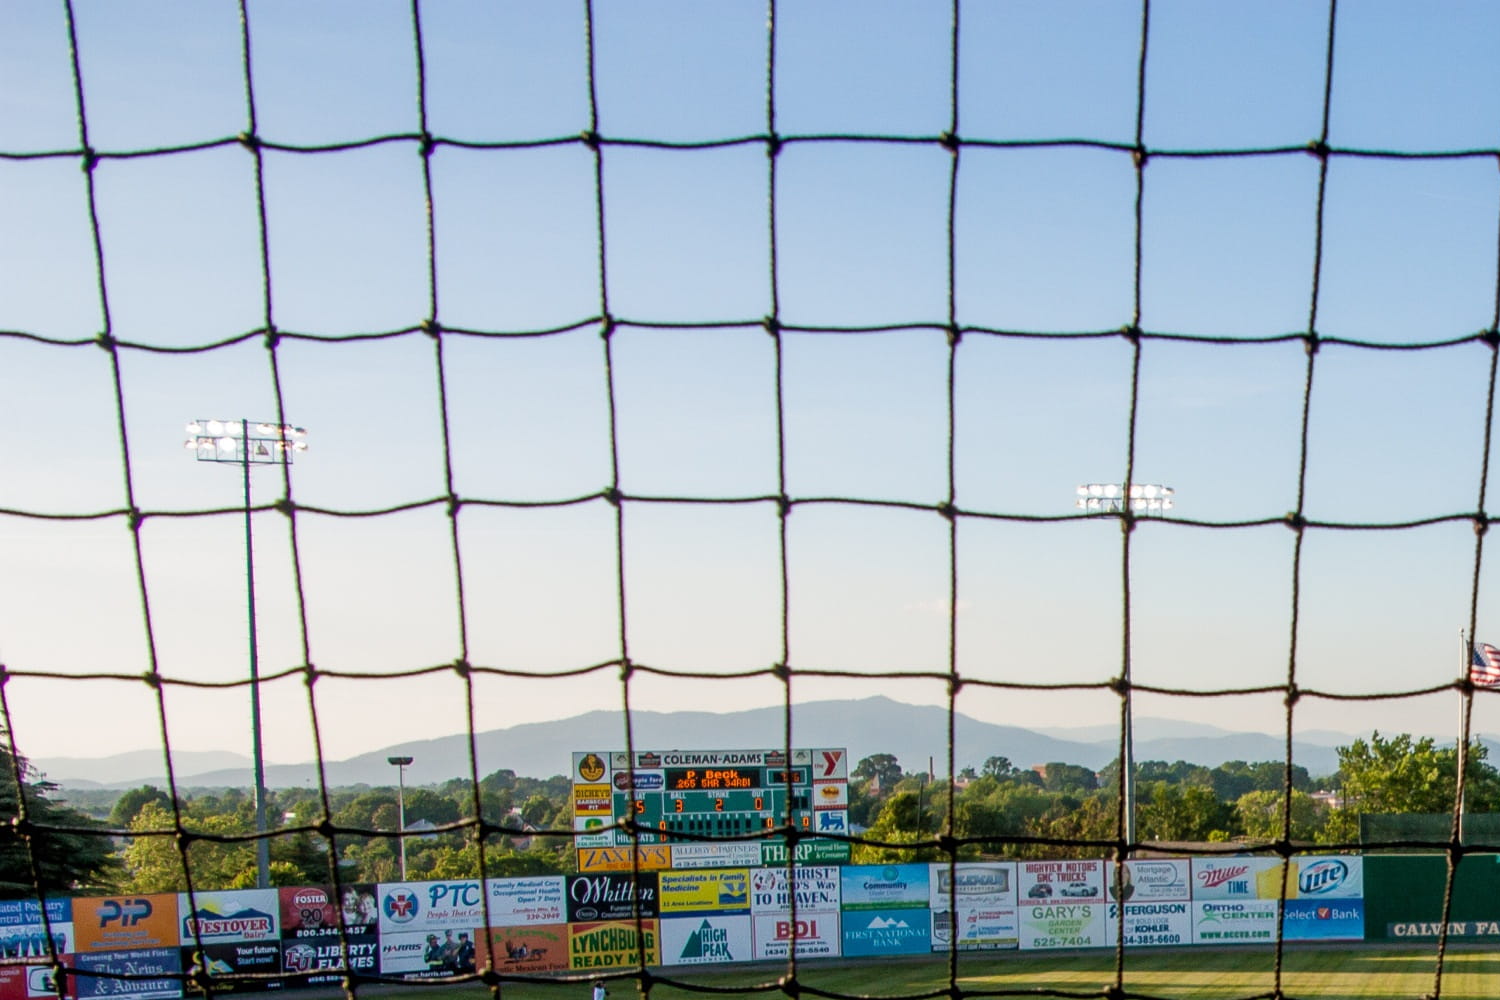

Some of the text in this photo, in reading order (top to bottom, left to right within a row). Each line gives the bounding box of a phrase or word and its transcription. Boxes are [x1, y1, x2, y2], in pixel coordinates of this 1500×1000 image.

[664, 754, 762, 767] COLEMAN-ADAMS
[705, 769, 738, 779] Beck
[670, 791, 687, 799] BALL
[707, 790, 730, 798] STRIKE
[675, 799, 684, 812] 3
[715, 798, 724, 812] 2
[754, 798, 763, 811] 0
[1026, 862, 1098, 873] HIGHVIEW MOTORS
[1136, 865, 1172, 875] Mortgage
[662, 873, 707, 884] Specialists
[719, 873, 746, 883] Family
[1037, 872, 1087, 883] GMC TRUCKS
[1197, 865, 1250, 889] Miller
[571, 877, 655, 904] Whittn
[662, 884, 701, 893] Medicine
[816, 880, 836, 891] Way
[863, 882, 908, 891] Community
[1228, 881, 1250, 894] TIME
[295, 895, 326, 904] FOSTER
[428, 882, 481, 909] PTC
[755, 893, 773, 906] TO
[300, 908, 323, 923] 90
[452, 909, 469, 919] That
[1032, 905, 1092, 920] GARY'S
[1125, 904, 1186, 916] FERGUSON
[1222, 911, 1274, 919] CENTER
[1282, 908, 1360, 920] Select Bank
[297, 926, 367, 937] 800.344.457
[776, 919, 818, 939] BDI
[845, 929, 928, 940] FIRST NATIONAL
[1135, 924, 1170, 934] KOHLER
[244, 931, 267, 940] Dairy
[571, 927, 655, 954] LYNCHBUG
[702, 928, 727, 942] HIGH
[873, 939, 902, 948] BANK
[1033, 936, 1092, 948] 525-7404
[236, 947, 253, 956] Your
[383, 943, 423, 953] HARRIS
[702, 942, 734, 960] PEAK
[237, 957, 255, 966] Start
[572, 952, 655, 969] READY MX
